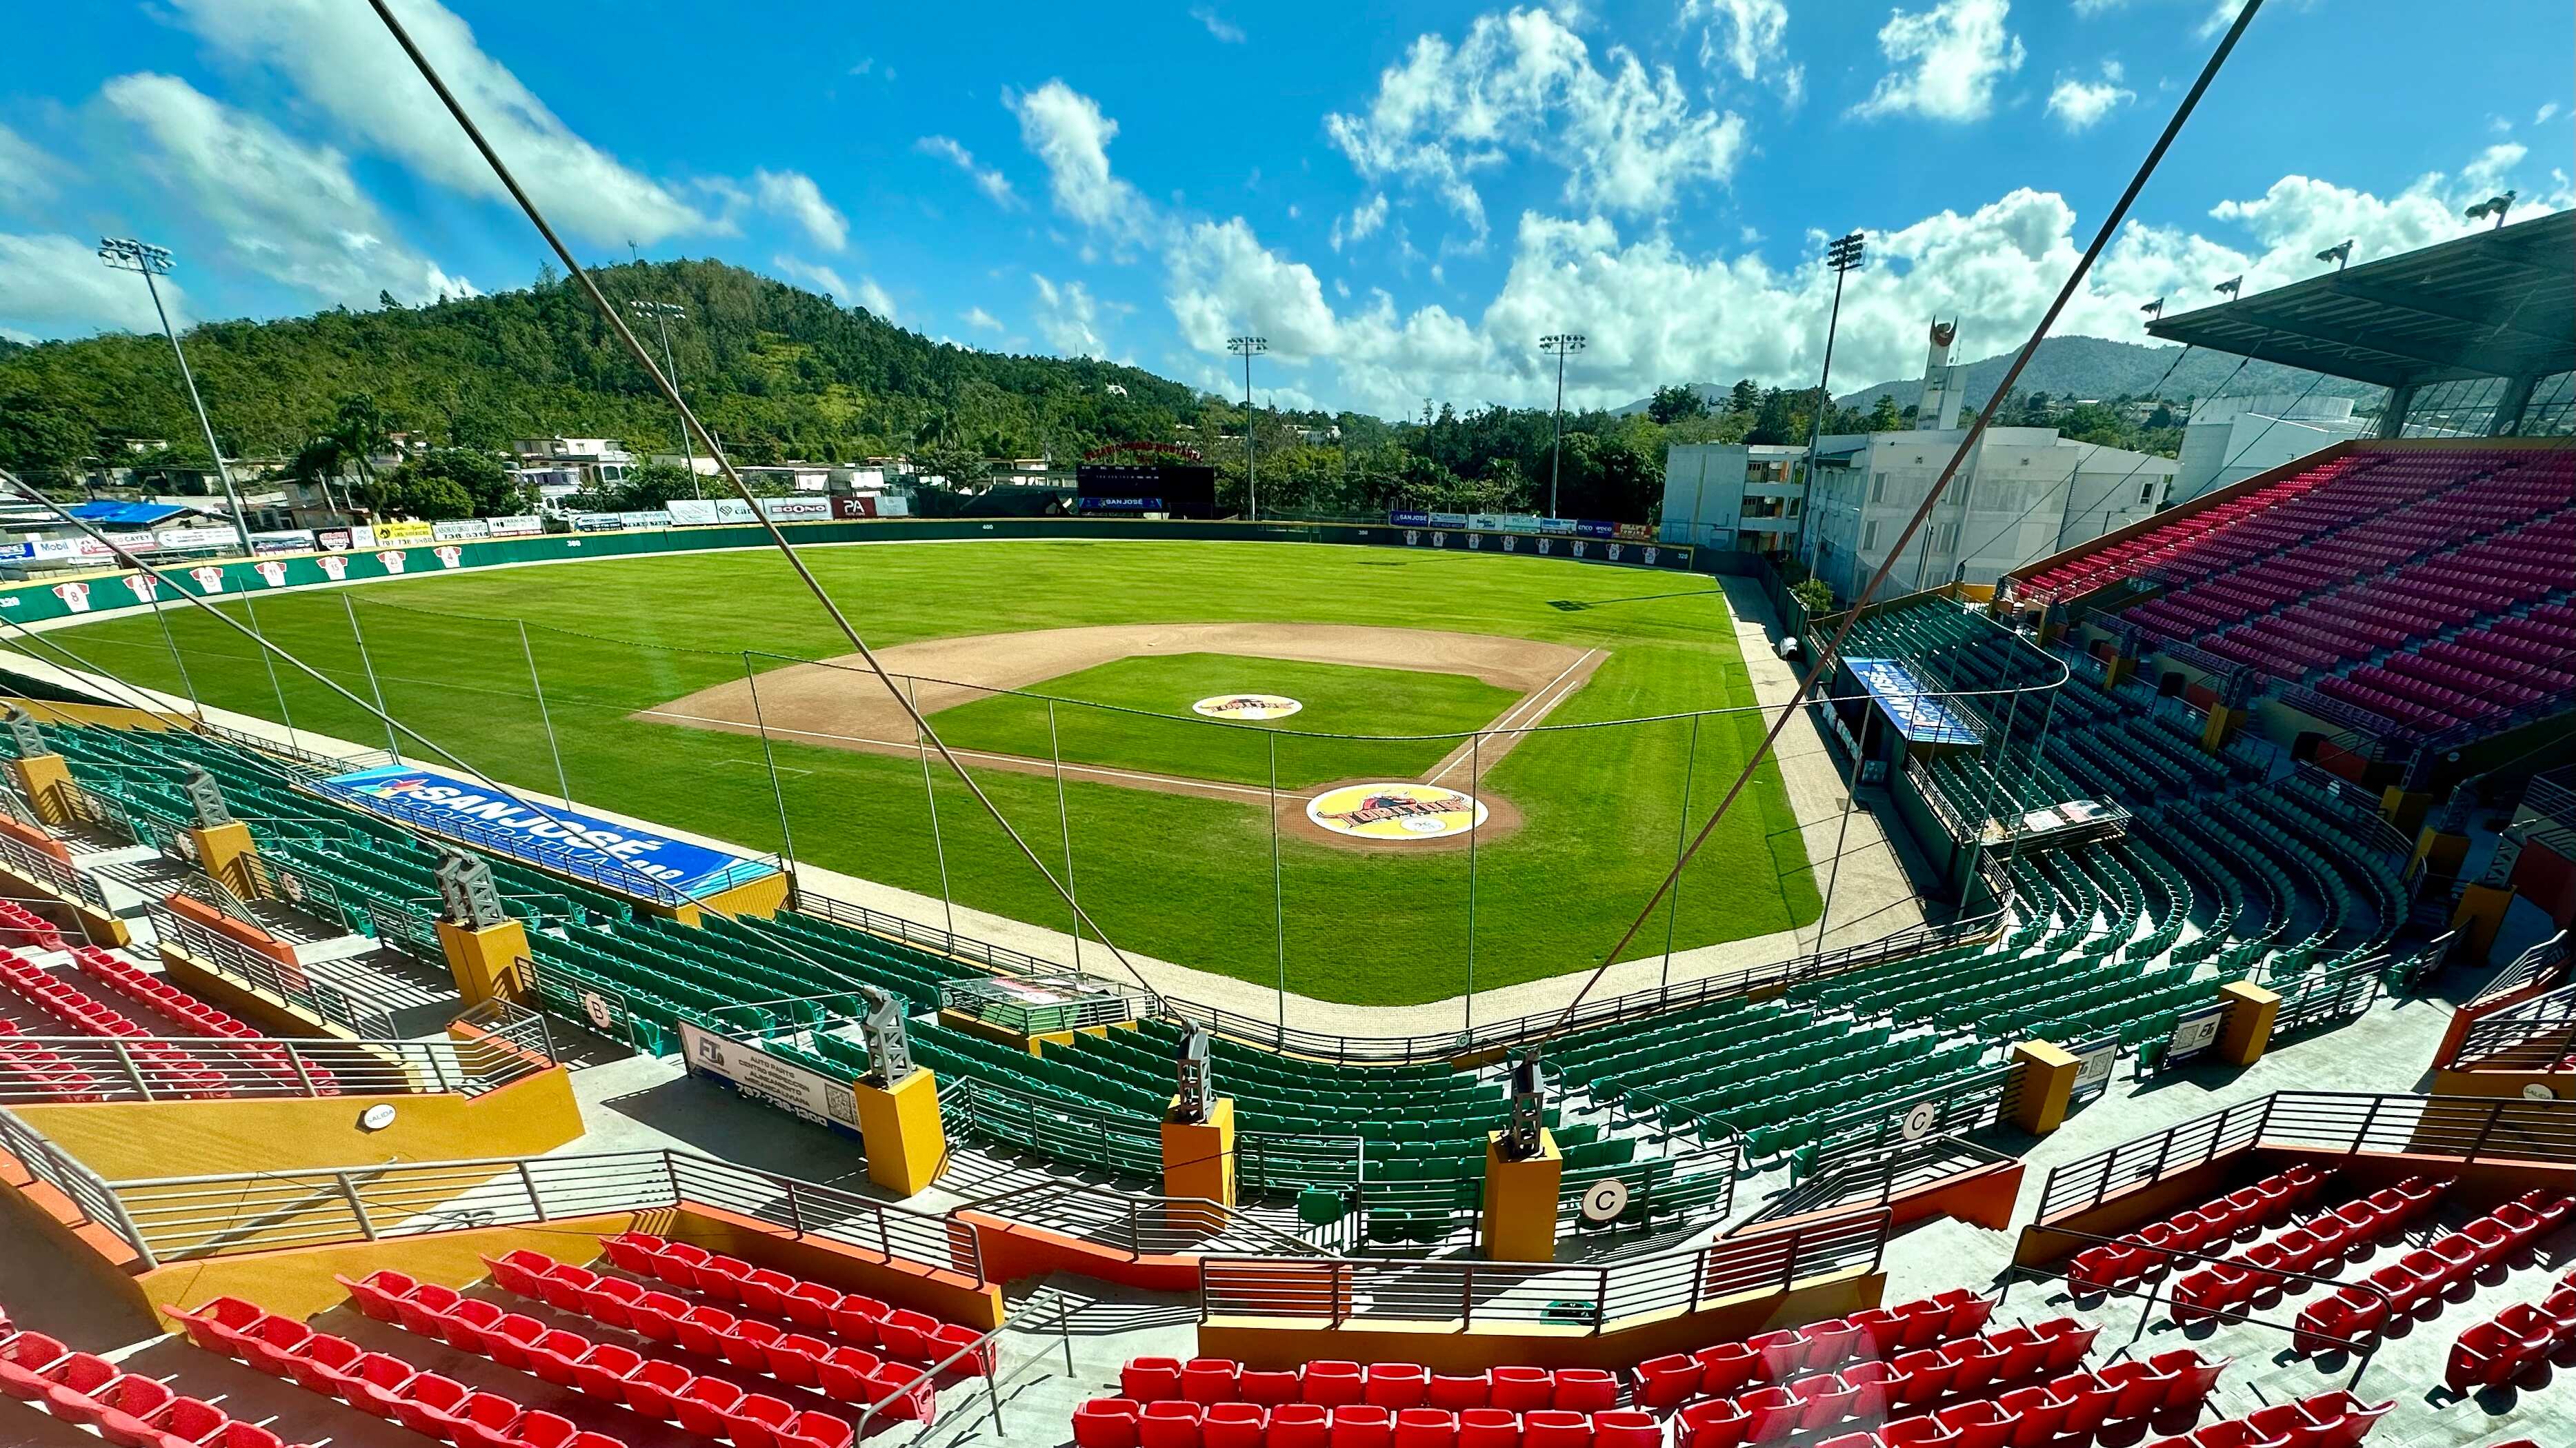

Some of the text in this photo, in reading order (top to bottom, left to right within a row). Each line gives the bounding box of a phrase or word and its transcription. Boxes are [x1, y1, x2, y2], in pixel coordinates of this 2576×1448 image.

[771, 505, 827, 513] ECONO
[40, 542, 69, 551] Mobil
[70, 592, 79, 602] 8
[1338, 798, 1472, 828] TORITOS
[591, 1000, 603, 1019] B
[738, 1059, 768, 1074] CENTRO
[750, 1056, 795, 1078] AUTO PARTS
[367, 1109, 394, 1124] SALIDA
[1911, 1112, 1926, 1131] C
[1595, 1190, 1616, 1211] C
